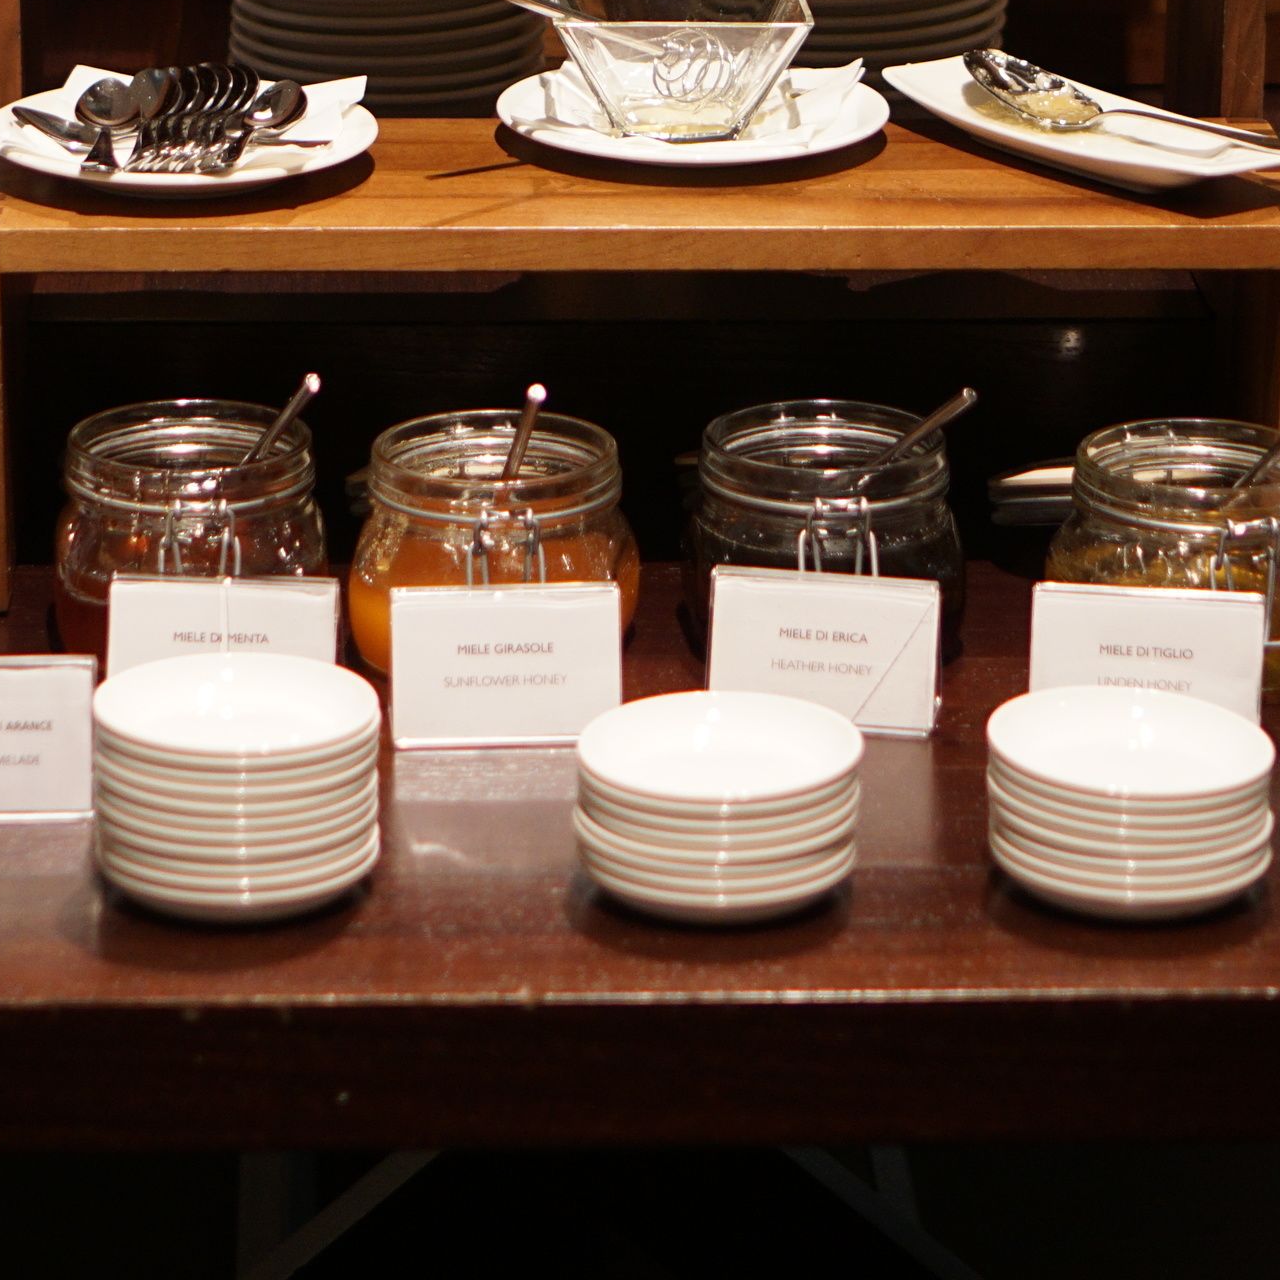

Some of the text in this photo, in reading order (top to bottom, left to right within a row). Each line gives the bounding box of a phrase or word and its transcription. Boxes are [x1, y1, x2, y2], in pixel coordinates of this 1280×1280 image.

[172, 631, 206, 643] MIELE
[227, 631, 270, 644] MENTA
[779, 626, 869, 645] MIELE DI ERICA
[457, 641, 555, 656] MIELE GIRASOLE
[1099, 643, 1194, 660] MIELE DI TIGLIO
[771, 657, 873, 676] HEATHER HONEY
[443, 673, 568, 689] SUNFLOWER HONEY
[1097, 675, 1193, 692] LINDEN HONEY
[5, 719, 53, 732] ARANCE
